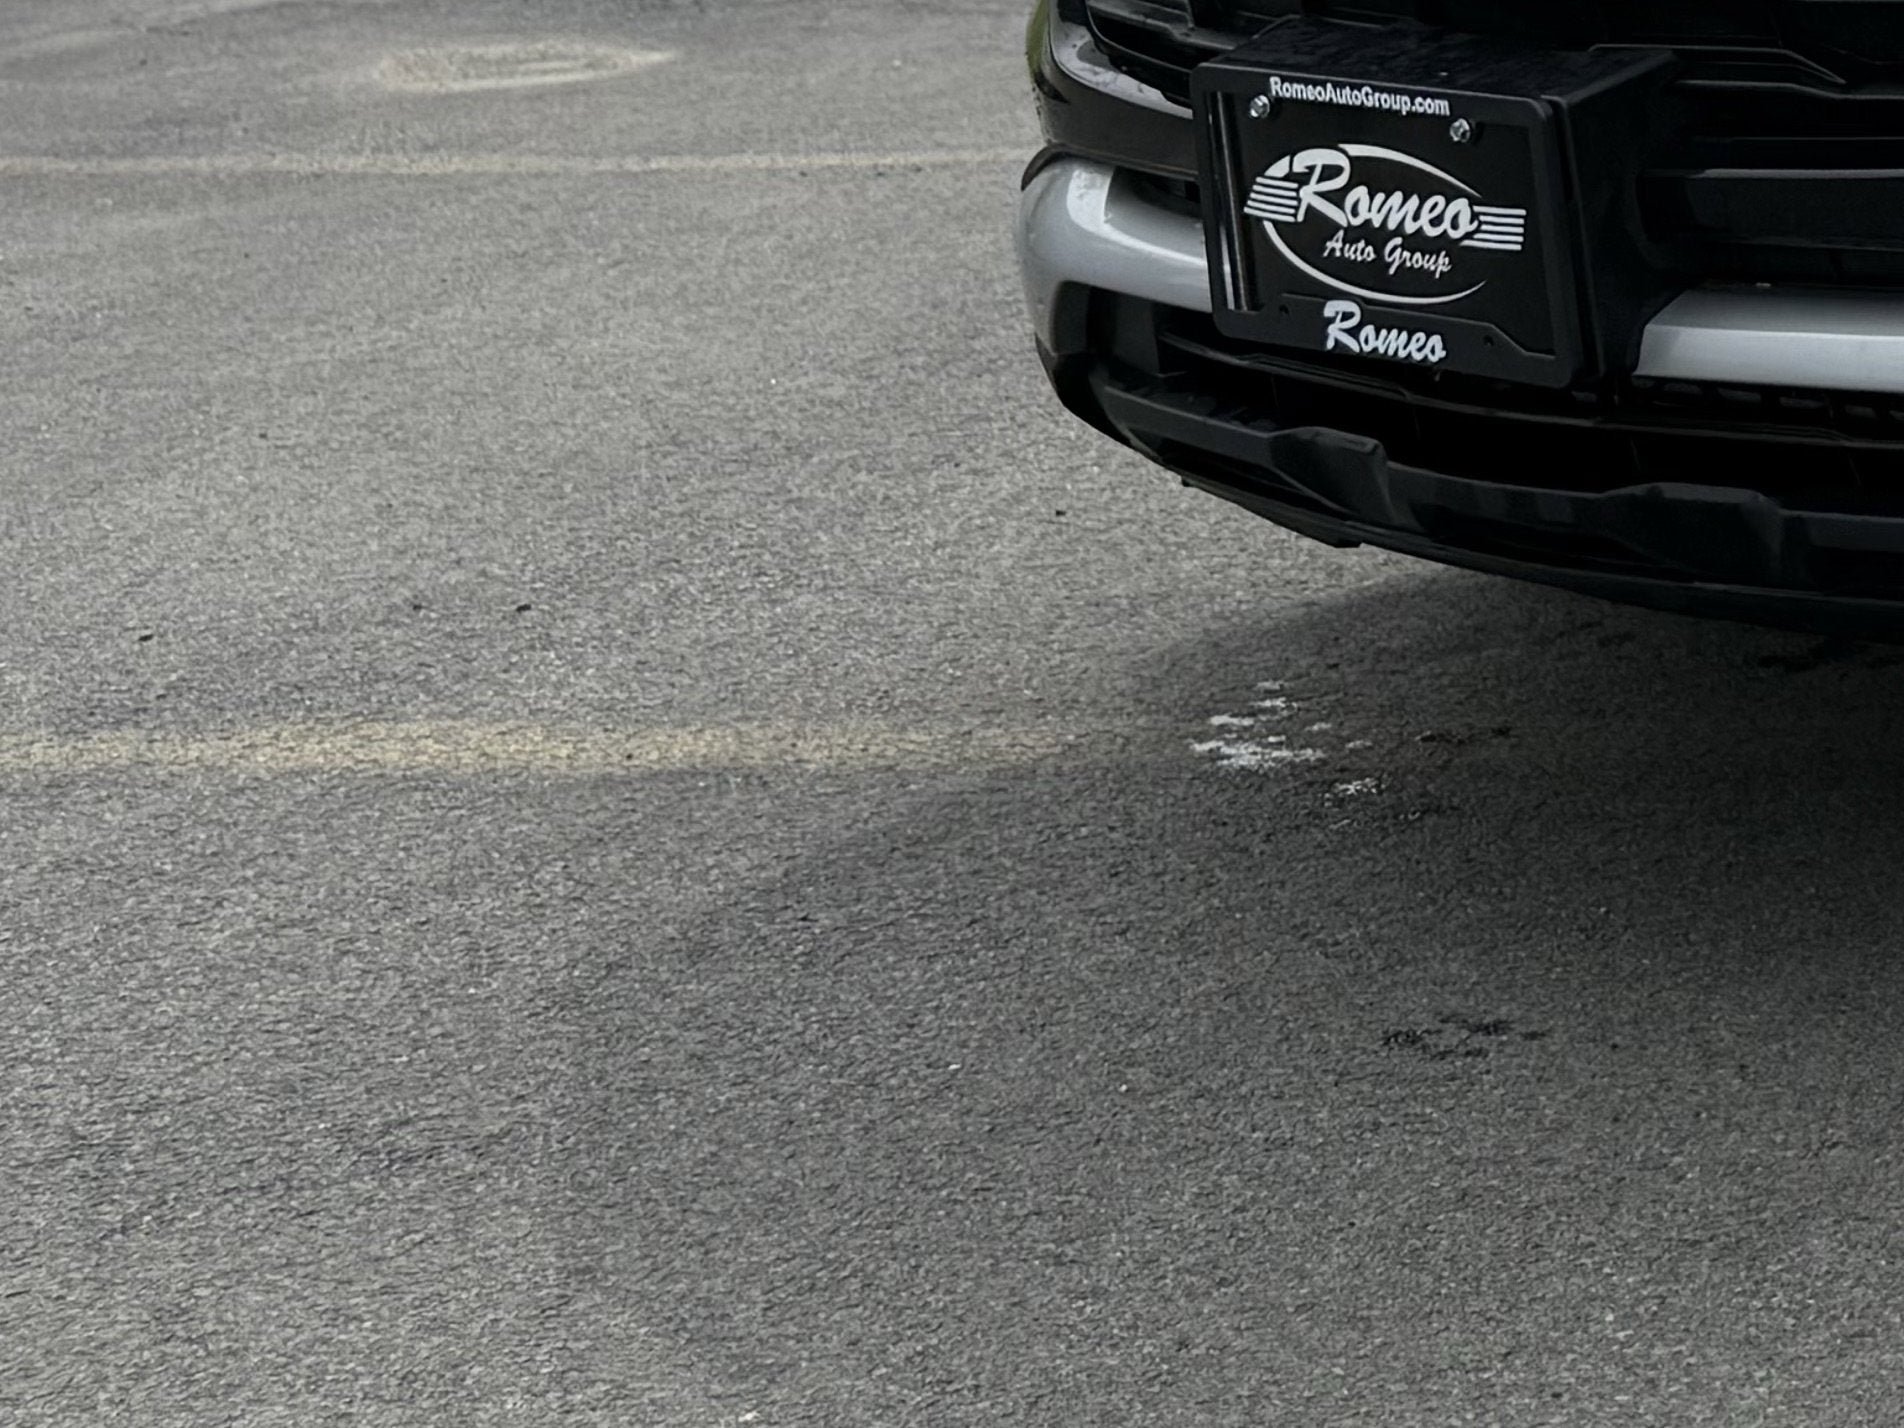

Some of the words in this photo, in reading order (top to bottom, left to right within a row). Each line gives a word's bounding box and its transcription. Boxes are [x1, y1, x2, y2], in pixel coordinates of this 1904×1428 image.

[1269, 75, 1450, 117] RomeoAutoGroup.com
[1292, 147, 1480, 240] Romeo
[1322, 228, 1377, 262] Auto
[1384, 237, 1453, 279] Group
[1322, 299, 1447, 364] Romeo
